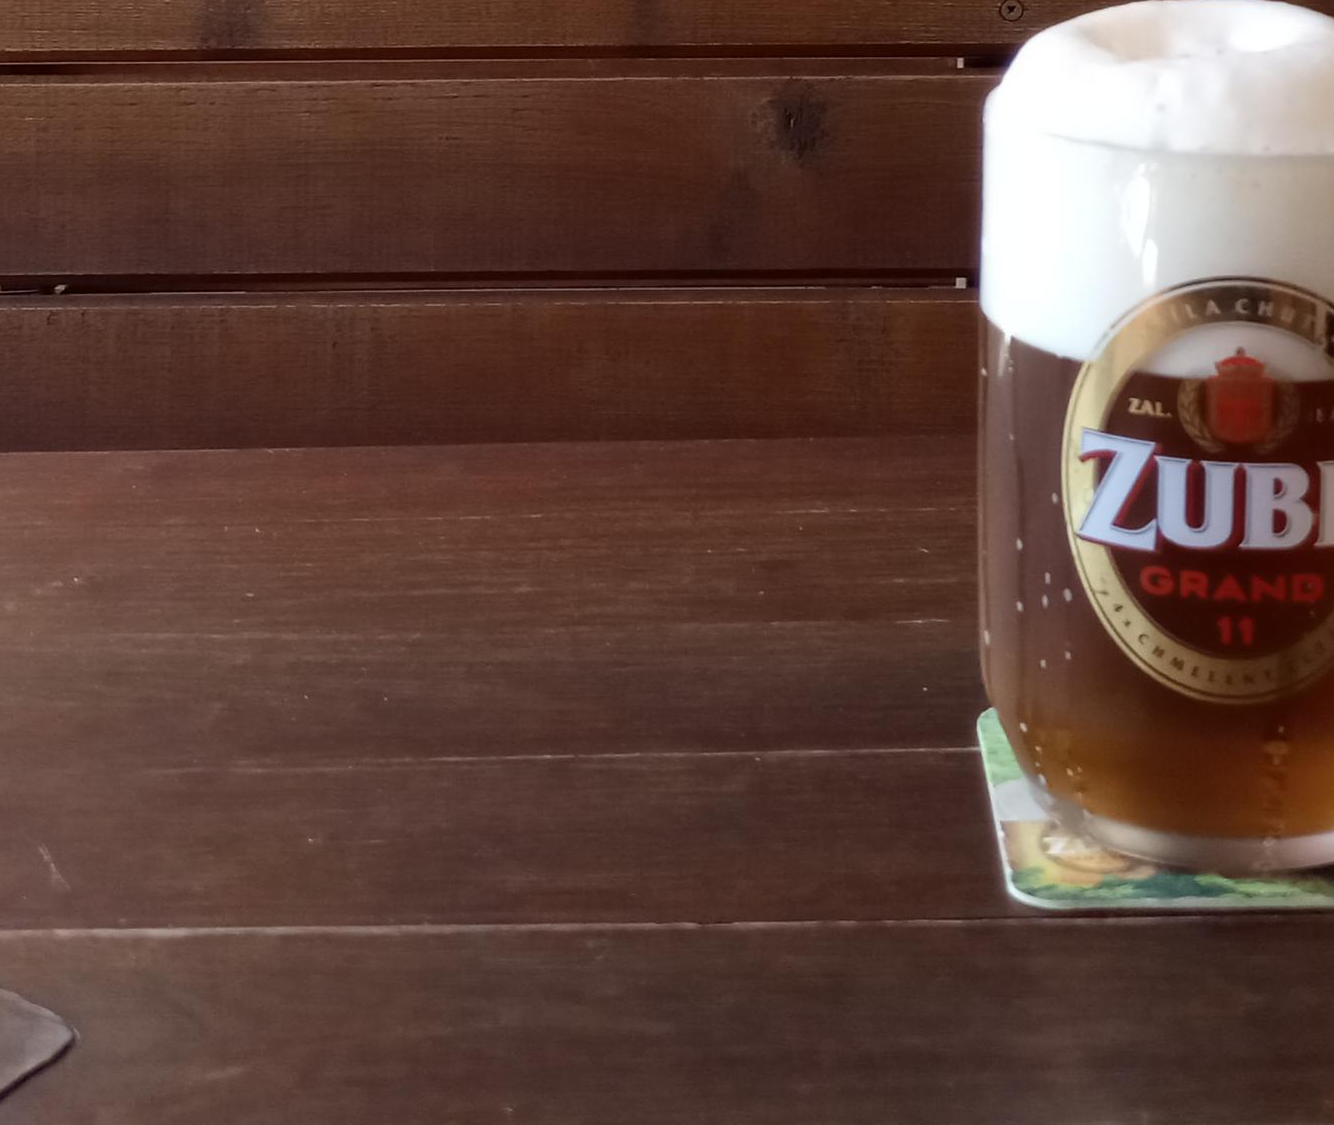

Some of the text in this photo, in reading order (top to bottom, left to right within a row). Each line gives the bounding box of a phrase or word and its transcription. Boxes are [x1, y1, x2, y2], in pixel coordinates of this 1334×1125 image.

[1127, 397, 1173, 418] ZAL.
[1140, 565, 1324, 603] GRAND
[1218, 616, 1255, 646] 11
